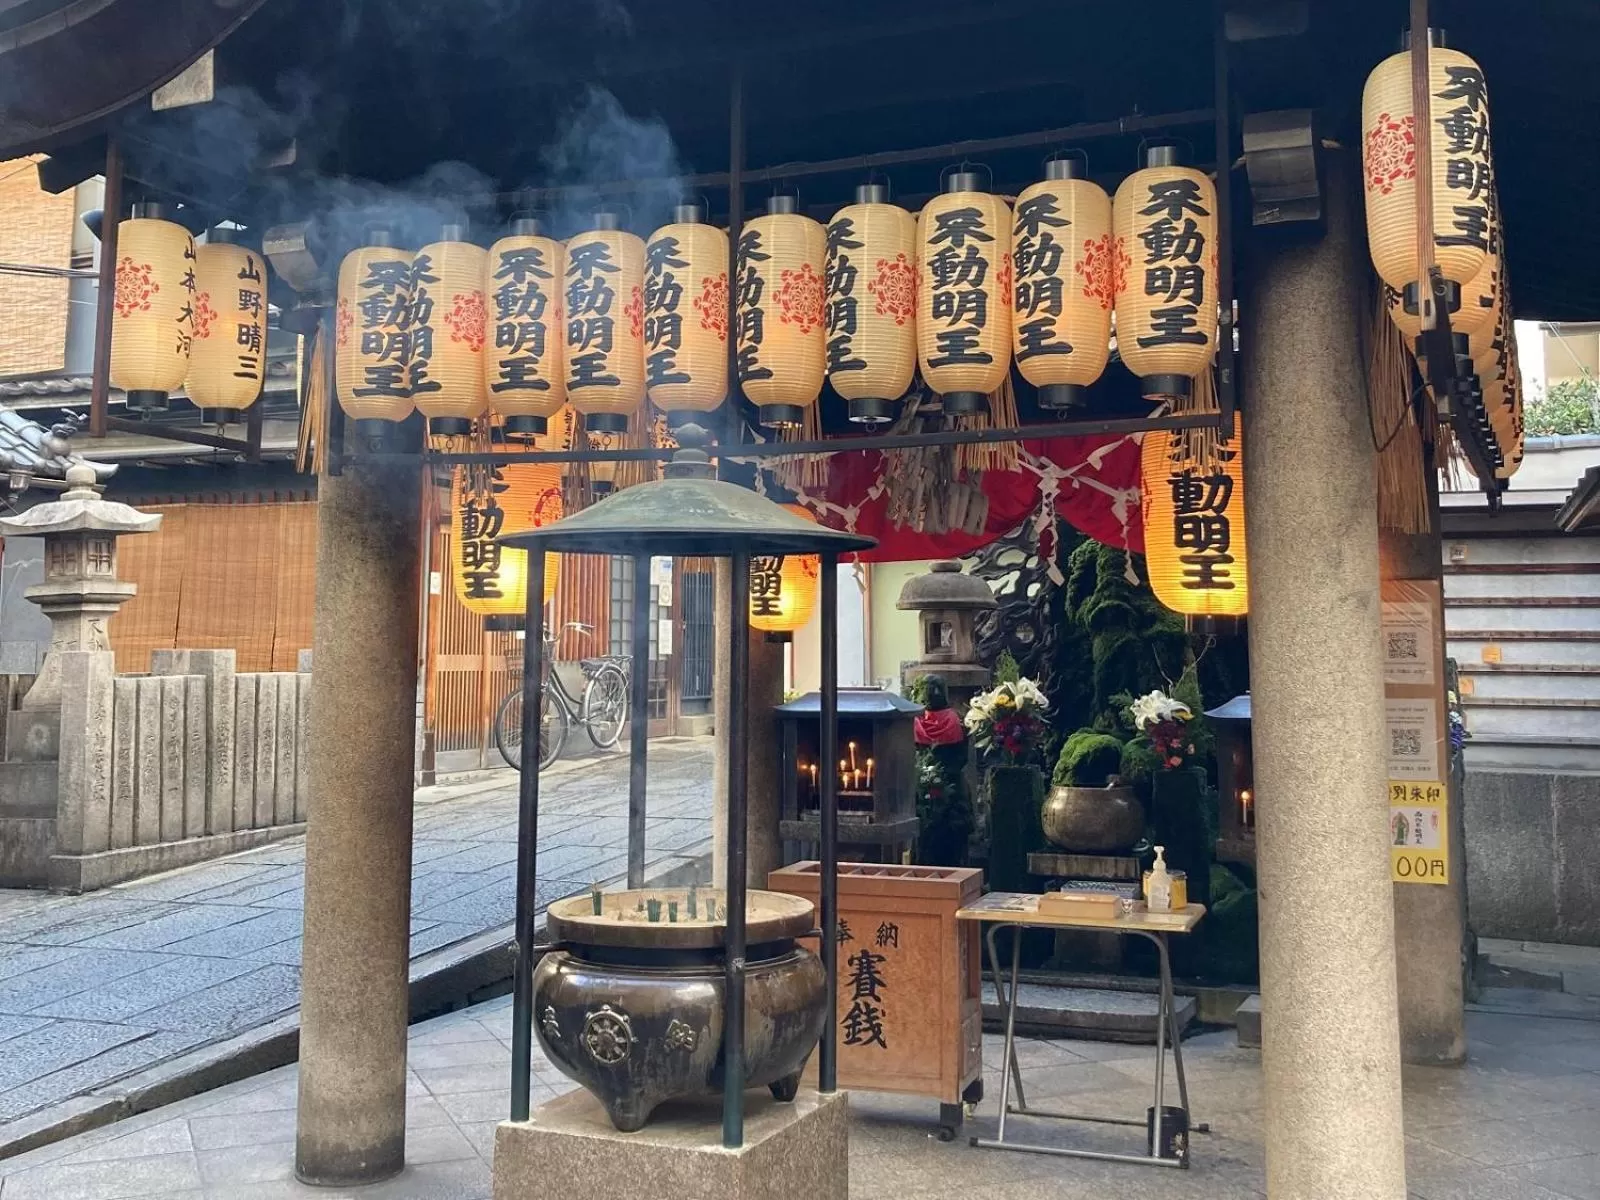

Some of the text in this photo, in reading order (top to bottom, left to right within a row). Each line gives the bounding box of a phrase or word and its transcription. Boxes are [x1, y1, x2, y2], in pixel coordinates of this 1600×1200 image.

[1433, 66, 1489, 248] 不動明王
[233, 255, 262, 381] 山野晴三
[353, 261, 411, 399] 不動明王
[492, 247, 554, 394] 不動明王
[564, 241, 622, 392] 不動明王
[644, 236, 691, 389] 不動明王
[926, 207, 995, 369] 不動明王
[1013, 193, 1072, 363] 不動明王
[1138, 178, 1210, 350] 不動明王
[1390, 784, 1440, 802] 別朱印
[840, 949, 888, 1049] 賽銭
